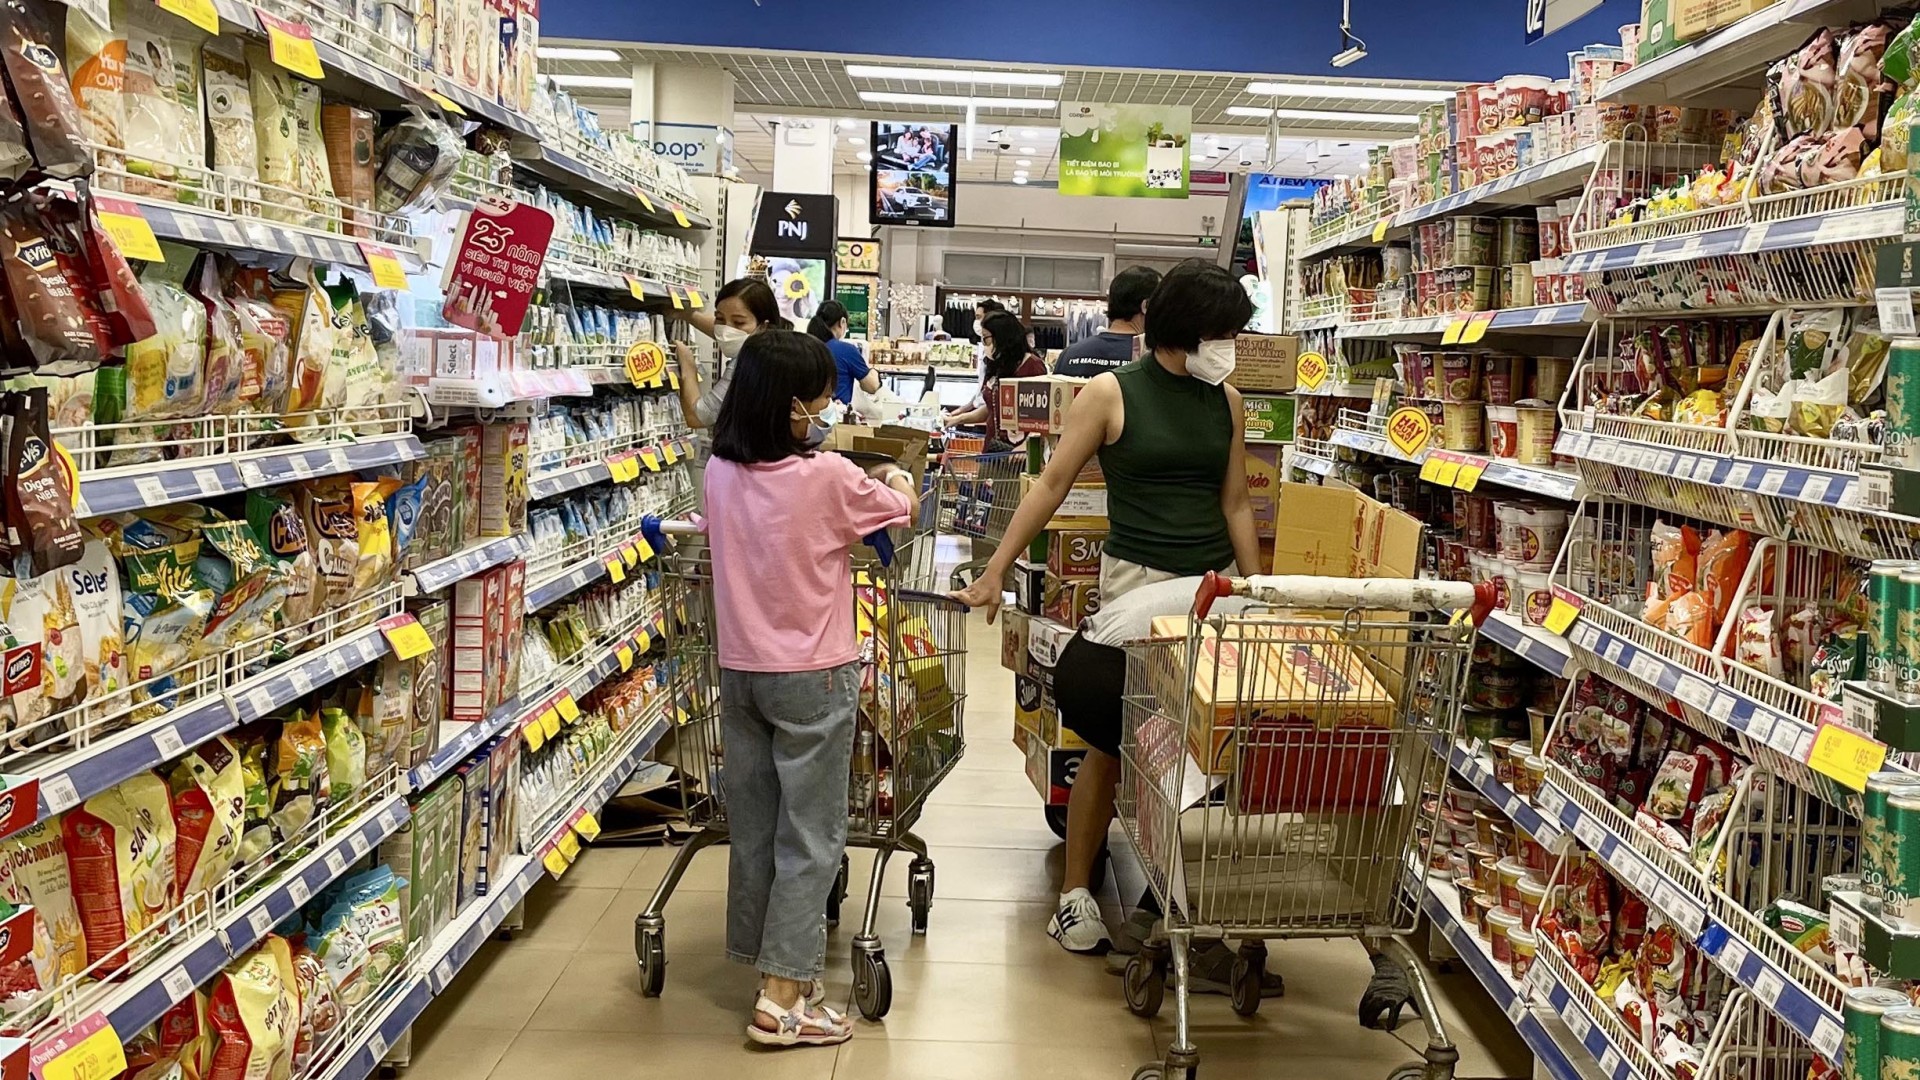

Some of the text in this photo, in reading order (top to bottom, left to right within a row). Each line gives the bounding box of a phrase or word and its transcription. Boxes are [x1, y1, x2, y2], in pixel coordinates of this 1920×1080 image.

[652, 141, 698, 160] o.op
[1260, 176, 1270, 185] A
[1275, 177, 1306, 187] NEW
[469, 218, 514, 254] 25
[778, 220, 808, 241] PNJ
[464, 249, 538, 280] SIÊU THỊ VIỆT
[508, 276, 534, 295] VIỆT
[1236, 349, 1257, 357] NAM
[1251, 339, 1275, 350] TIẾU
[446, 343, 458, 375] Select
[1080, 358, 1108, 366] REACHED
[1019, 390, 1048, 409] PHỞ BÒ
[1070, 538, 1105, 561] 3M
